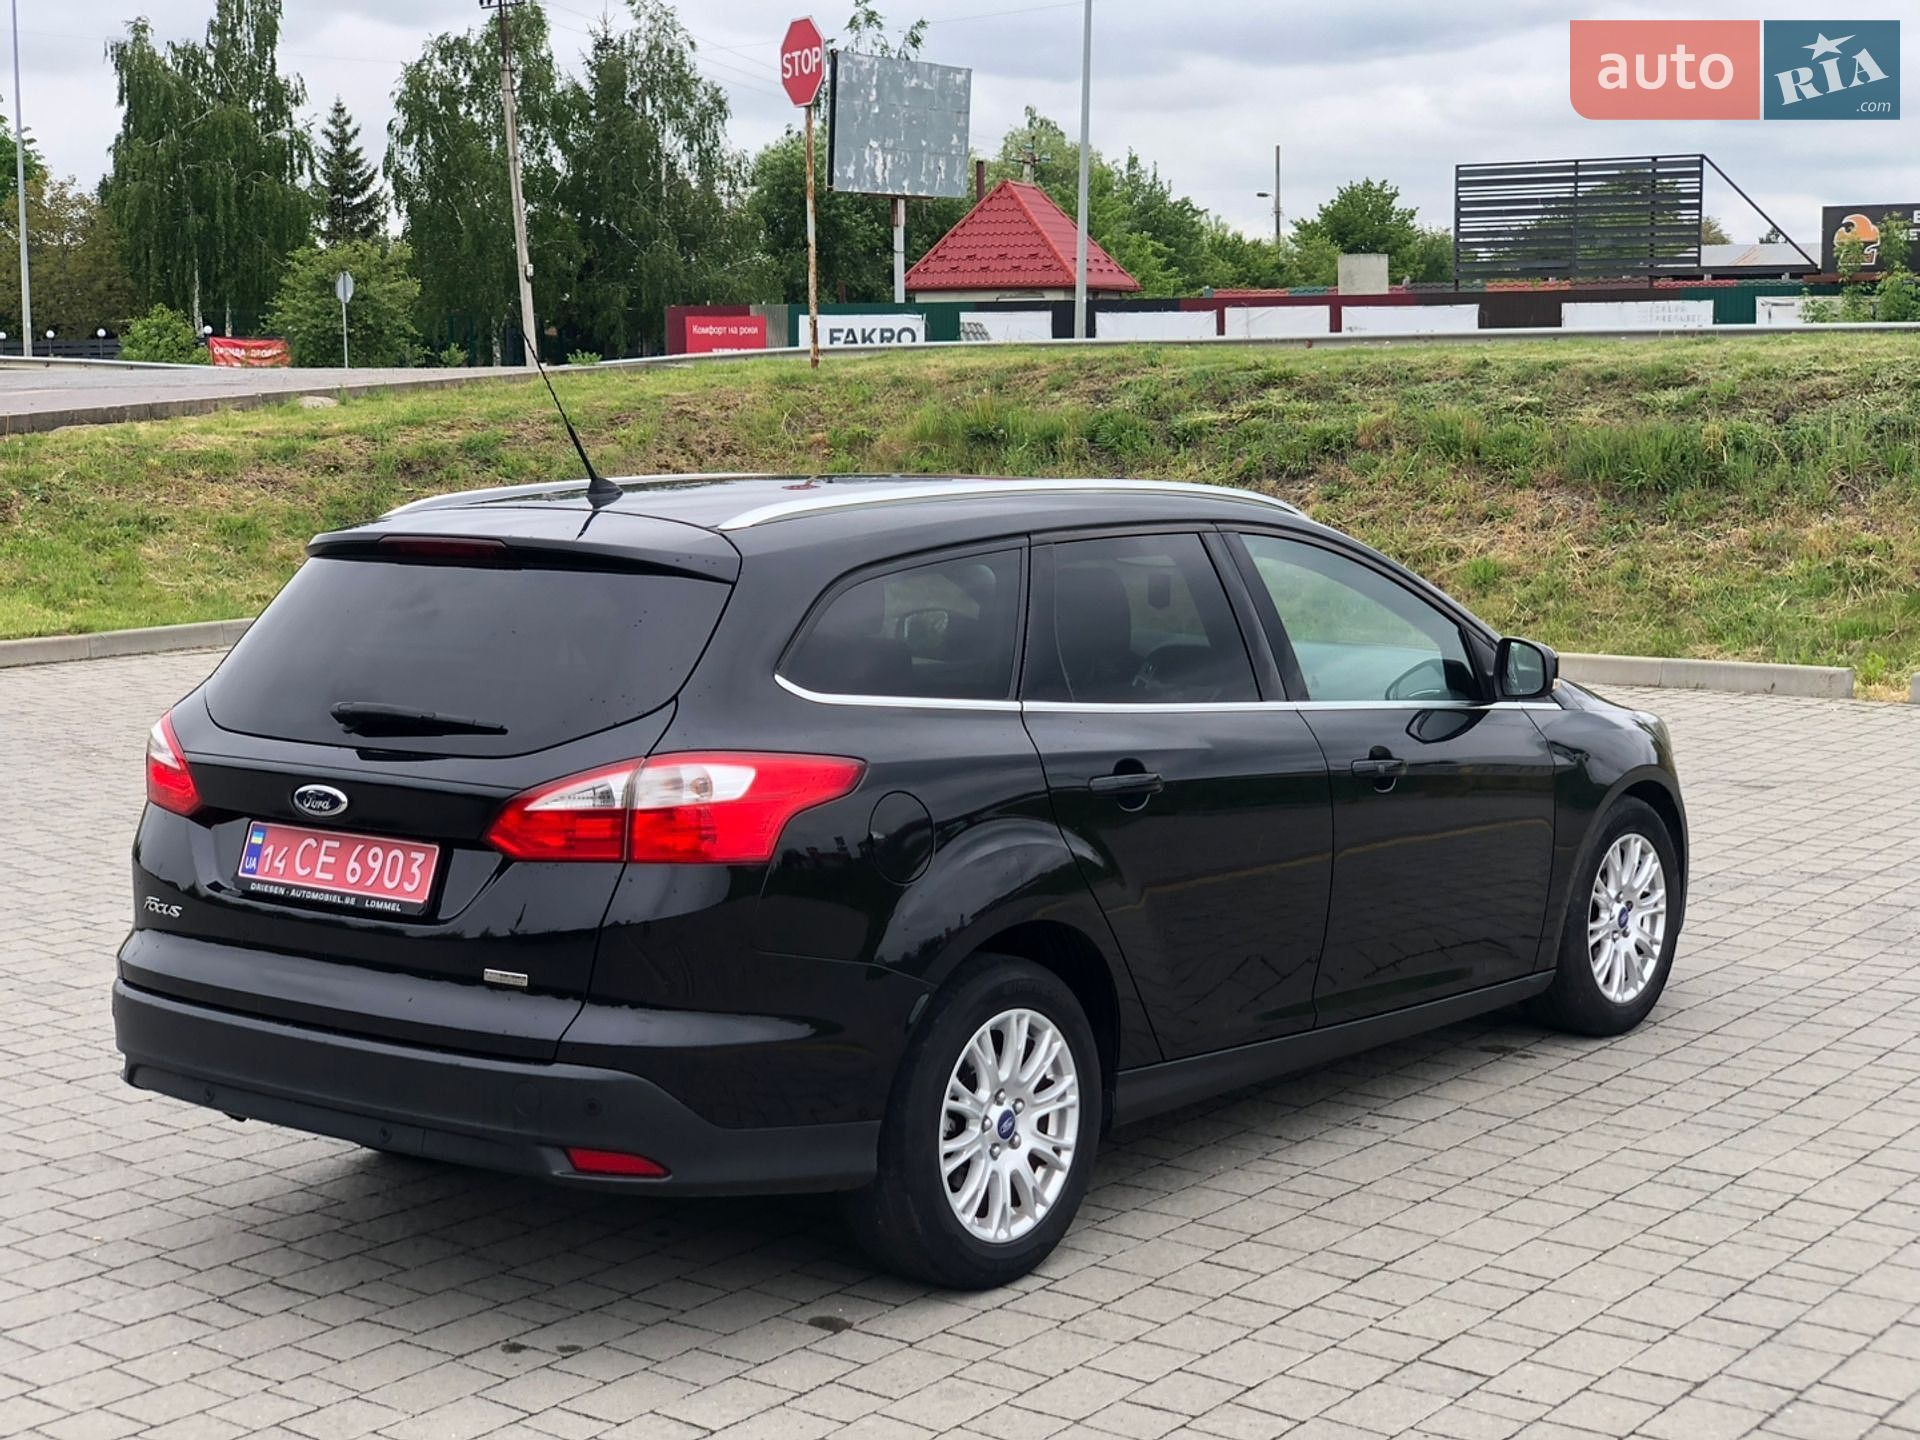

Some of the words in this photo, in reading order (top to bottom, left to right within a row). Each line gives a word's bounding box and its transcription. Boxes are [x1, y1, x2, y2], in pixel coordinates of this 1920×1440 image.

[782, 48, 821, 78] STOP
[692, 324, 726, 336] Комфорт
[728, 326, 738, 334] на
[740, 326, 758, 336] роки
[829, 327, 916, 345] FAKRO
[302, 790, 331, 810] Ford
[245, 856, 257, 870] UA
[263, 845, 289, 875] 14
[295, 837, 340, 880] CE
[346, 844, 426, 892] 6903
[365, 898, 401, 912] LOMMEL
